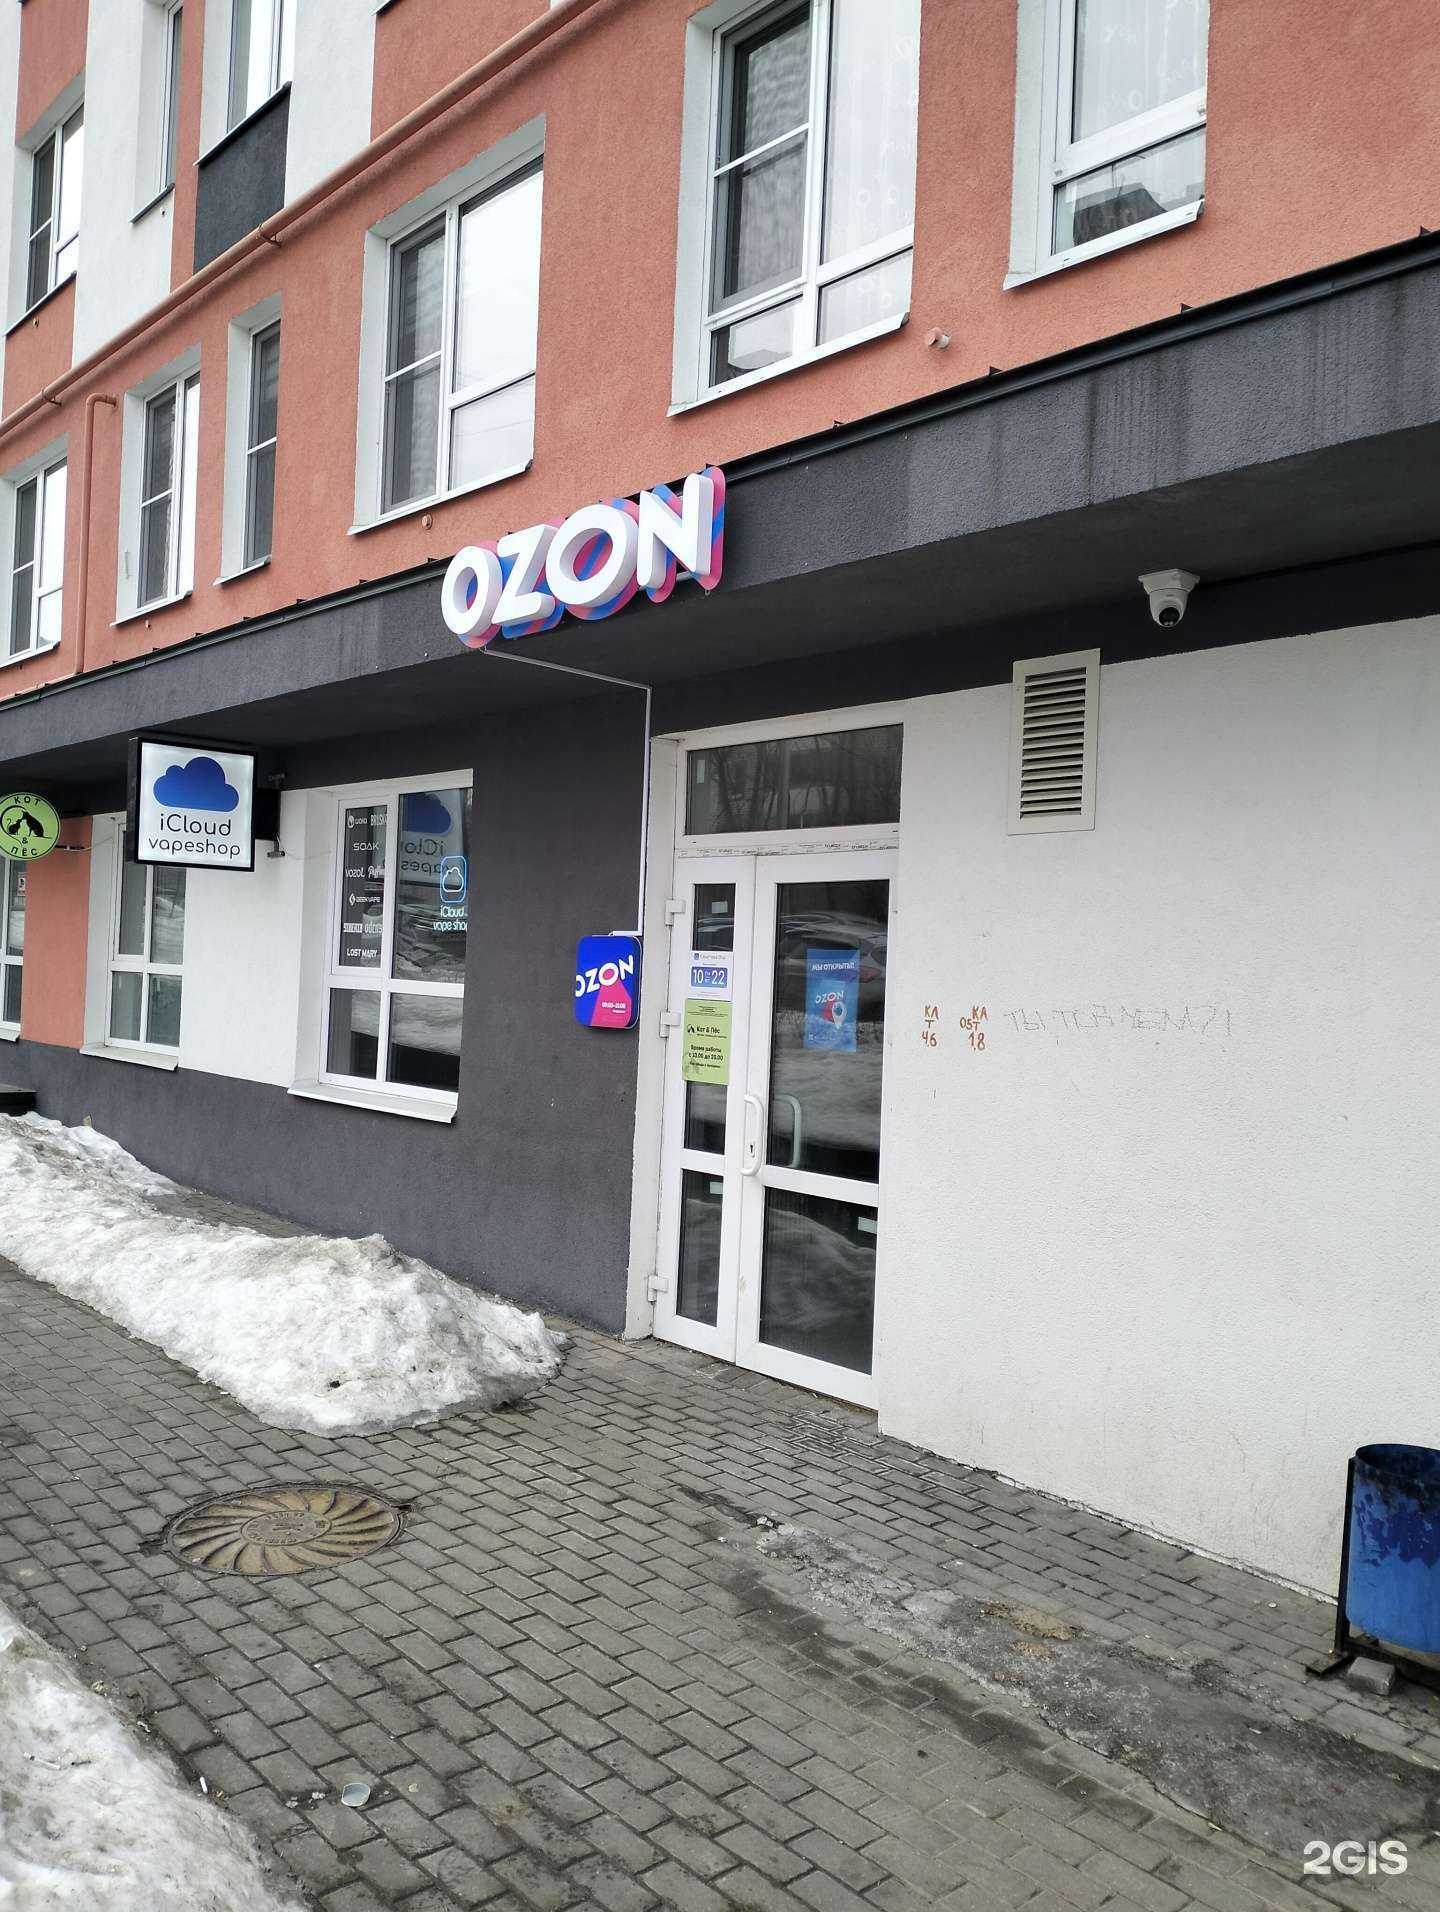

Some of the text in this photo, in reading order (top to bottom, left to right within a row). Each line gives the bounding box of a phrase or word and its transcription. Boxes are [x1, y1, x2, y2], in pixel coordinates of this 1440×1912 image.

[441, 468, 722, 644] OZON
[14, 796, 41, 806] КОТ
[160, 813, 231, 837] iCloud
[11, 846, 38, 857] ПЁС
[148, 838, 240, 860] vapeshop
[575, 954, 634, 998] OZON
[712, 970, 725, 985] 22
[815, 989, 845, 1004] OZON
